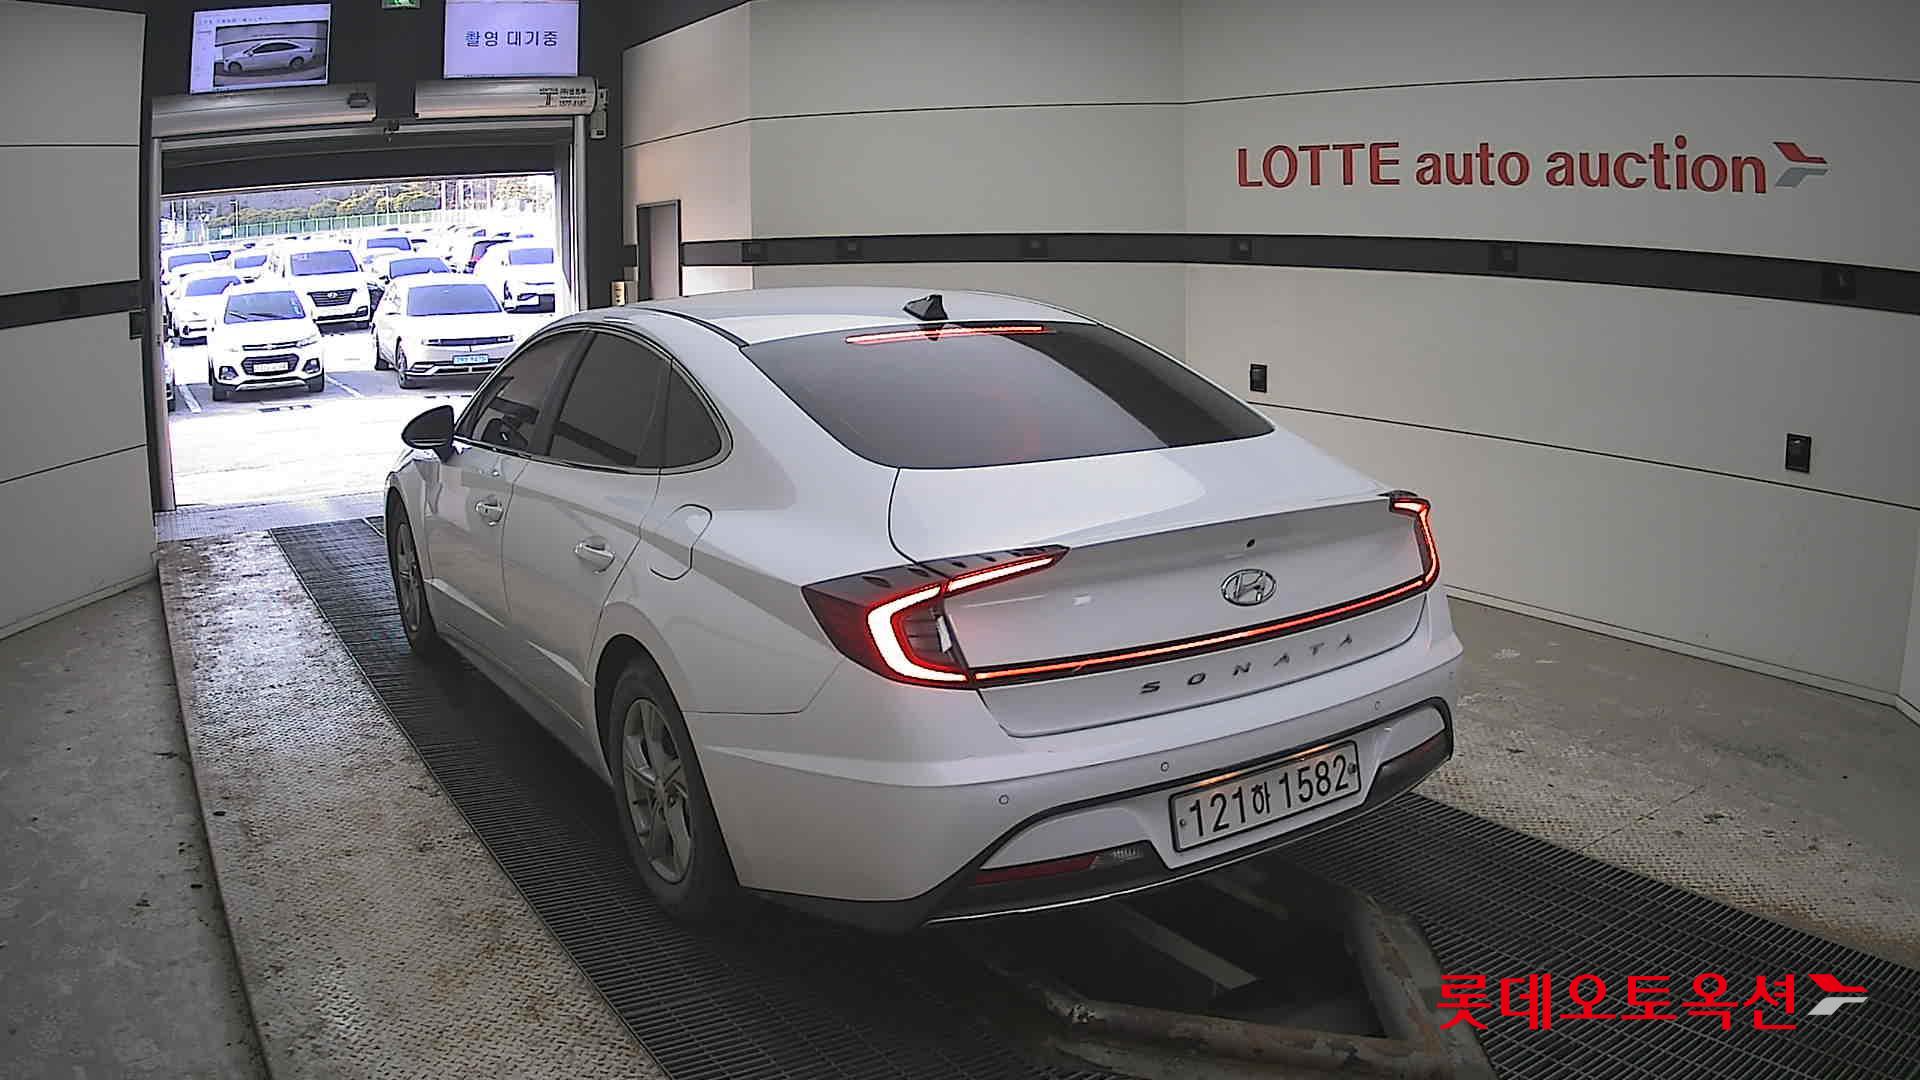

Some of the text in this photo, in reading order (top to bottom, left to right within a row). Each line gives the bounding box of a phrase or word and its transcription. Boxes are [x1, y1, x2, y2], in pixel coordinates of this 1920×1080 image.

[465, 31, 559, 48] 촬영 대기중
[1237, 134, 1767, 195] LOTTE auto auction
[1139, 633, 1354, 695] SONATA
